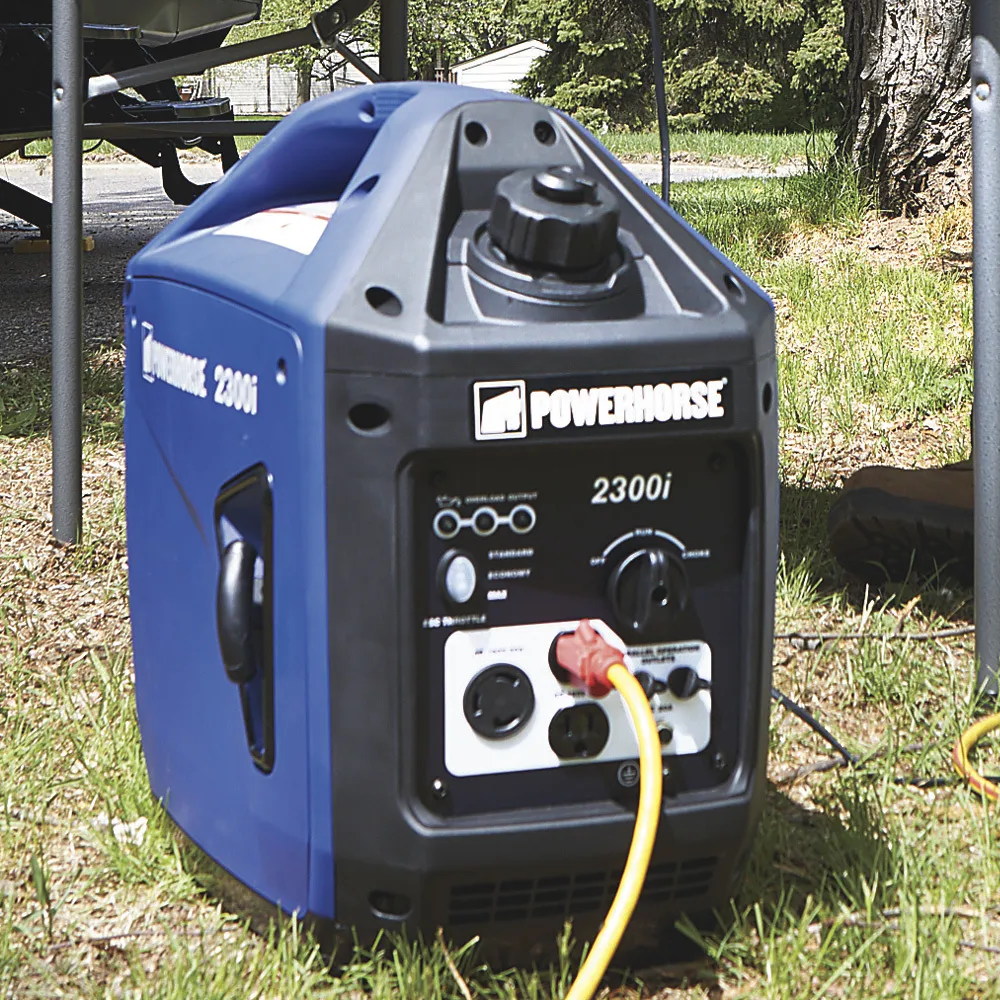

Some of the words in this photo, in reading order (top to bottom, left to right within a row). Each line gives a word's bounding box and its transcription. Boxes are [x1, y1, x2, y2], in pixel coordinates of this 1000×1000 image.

[151, 339, 208, 398] POWERHORSE
[214, 364, 258, 415] 2300i
[530, 380, 726, 430] POWERHORSE
[591, 472, 672, 504] 2300i
